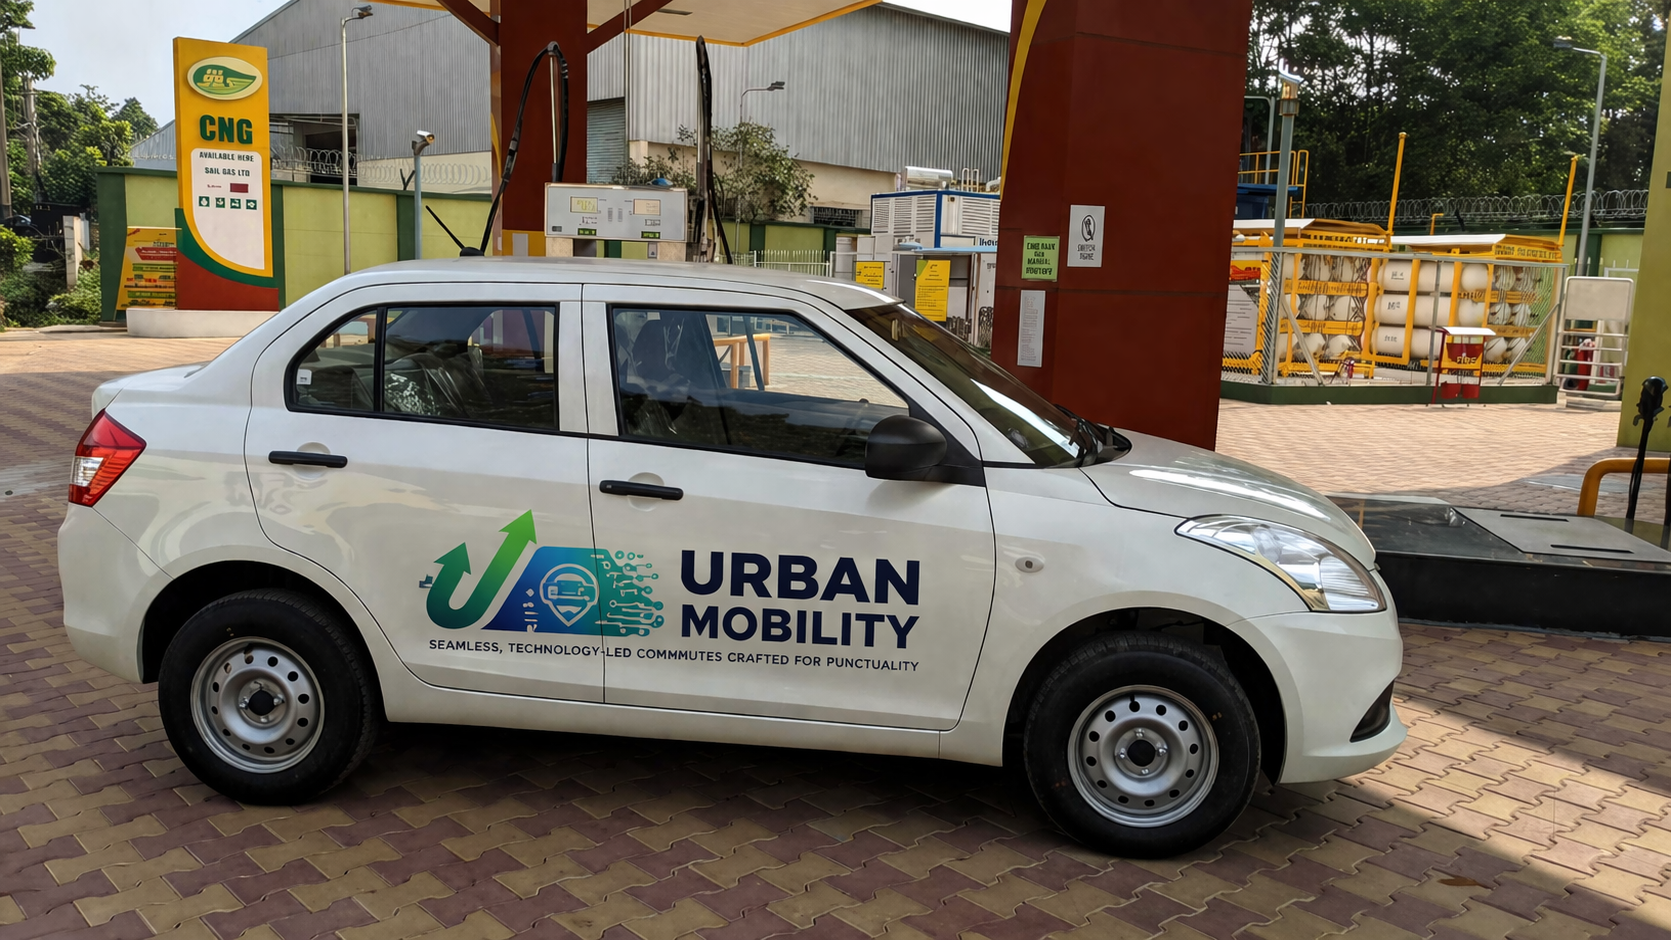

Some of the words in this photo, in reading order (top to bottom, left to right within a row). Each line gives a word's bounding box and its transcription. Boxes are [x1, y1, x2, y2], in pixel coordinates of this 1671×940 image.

[199, 114, 253, 145] CNG
[199, 151, 235, 161] AVAILABLE
[204, 166, 221, 175] SAIL
[222, 168, 236, 176] GAS
[681, 549, 920, 606] URBAN
[681, 603, 920, 649] MOBILITY
[429, 639, 503, 655] SEAMLESS,
[508, 642, 632, 658] TECHNOLOGY-LED
[636, 648, 723, 662] COMMMUTES
[727, 652, 790, 665] CRAFTED
[794, 655, 822, 667] FOR
[826, 656, 920, 672] PUNCTUALITY
